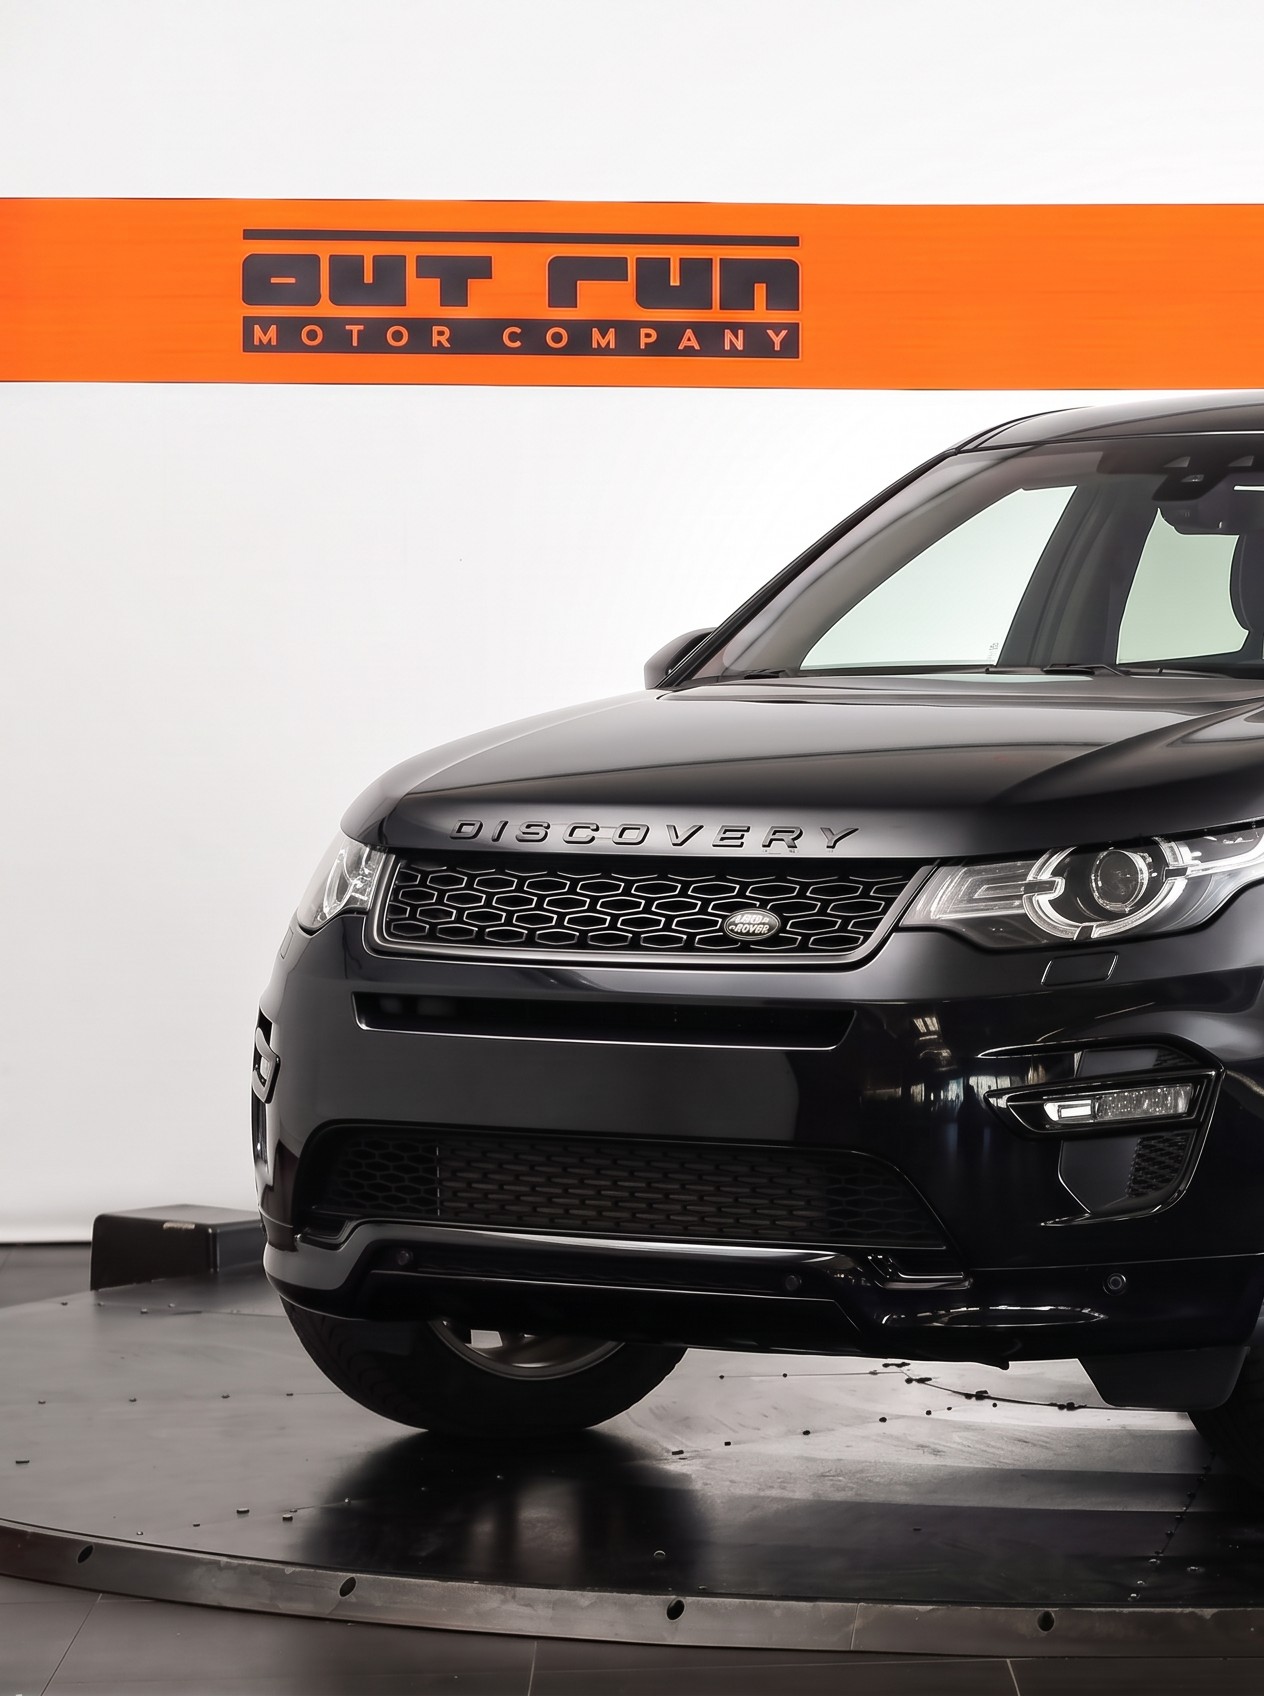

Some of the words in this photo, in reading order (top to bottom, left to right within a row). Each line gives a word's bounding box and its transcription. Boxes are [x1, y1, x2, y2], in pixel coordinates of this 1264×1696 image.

[242, 253, 493, 307] OUT
[253, 324, 451, 347] MOTOR
[502, 326, 788, 351] COMPANY
[449, 819, 859, 848] DISCOVERY
